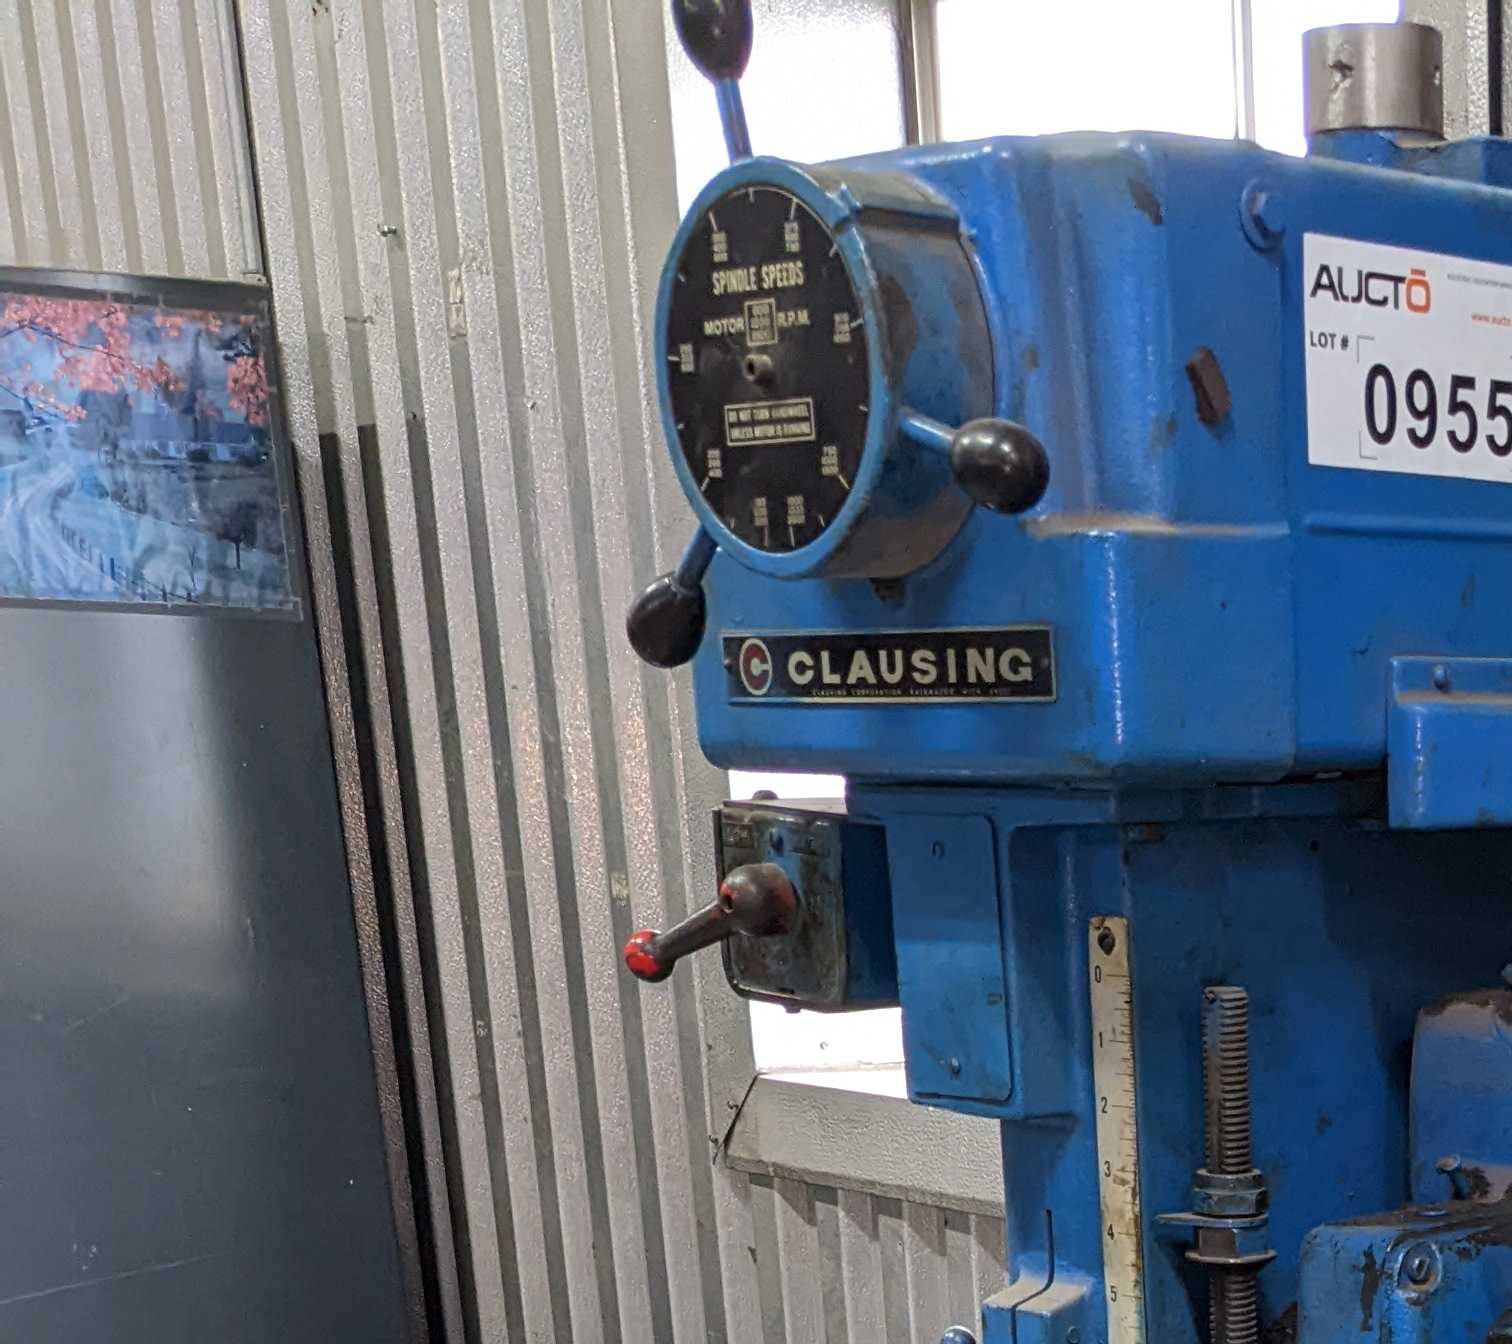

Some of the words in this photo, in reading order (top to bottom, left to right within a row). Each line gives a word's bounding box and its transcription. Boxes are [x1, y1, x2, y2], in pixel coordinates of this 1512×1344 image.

[712, 266, 757, 296] SPINDLE
[761, 260, 805, 289] SPEEDS
[704, 317, 745, 336] MOTOR
[1310, 331, 1336, 349] LOT
[1341, 336, 1349, 350] #
[787, 648, 1034, 685] CLAUSING
[1094, 965, 1101, 983] 0
[1098, 1031, 1103, 1048] 1
[1101, 1096, 1108, 1114] 2
[1104, 1160, 1111, 1178] 3
[1107, 1223, 1115, 1240] 4
[1110, 1285, 1117, 1302] 5
